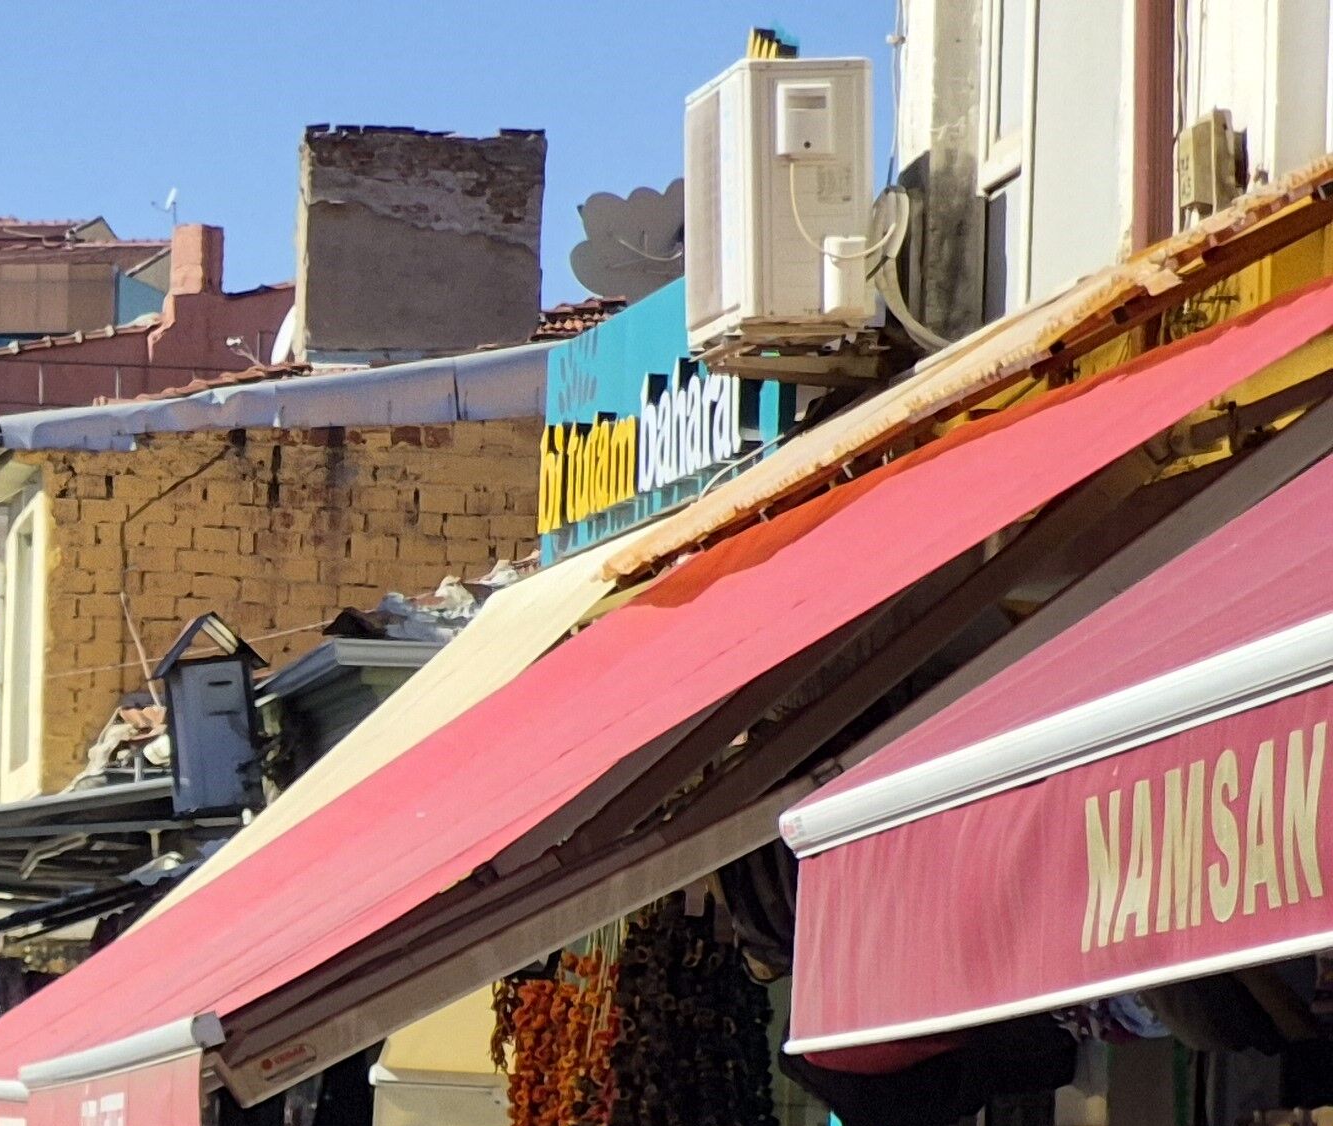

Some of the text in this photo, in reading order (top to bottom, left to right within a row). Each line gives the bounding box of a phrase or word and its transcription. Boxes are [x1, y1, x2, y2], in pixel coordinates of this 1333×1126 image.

[537, 422, 564, 535] bi
[566, 410, 637, 525] tutam
[1080, 720, 1328, 954] NAMSAN
